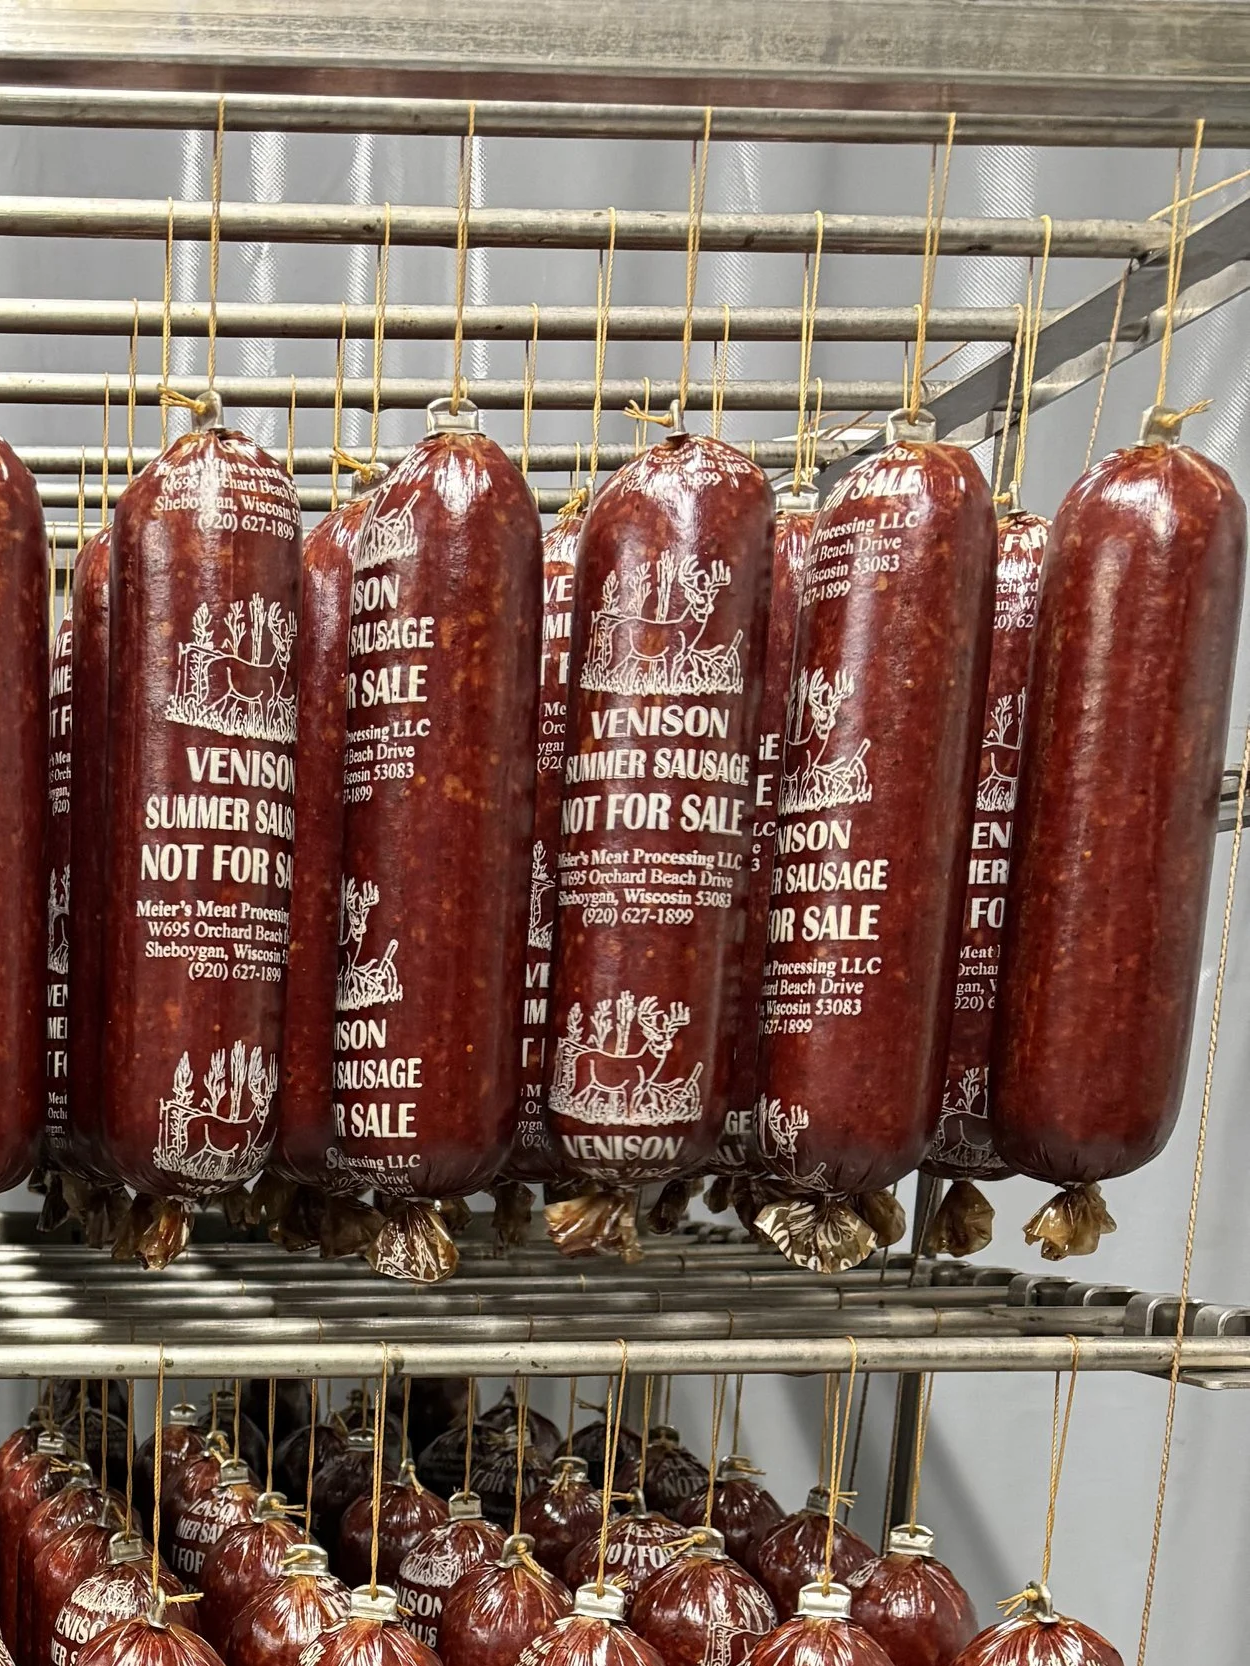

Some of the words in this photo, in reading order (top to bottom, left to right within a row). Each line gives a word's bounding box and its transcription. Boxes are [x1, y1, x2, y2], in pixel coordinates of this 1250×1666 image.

[879, 511, 919, 529] LLC
[858, 536, 903, 553] Drive
[351, 616, 435, 658] SAUSAGE
[361, 665, 428, 708] SALE
[392, 718, 431, 738] LLC
[591, 705, 730, 740] VENISON
[376, 742, 415, 761] Drive
[373, 762, 415, 781] 53083
[565, 749, 647, 785] SUMMER
[653, 748, 750, 787] SAUSAGE
[145, 794, 249, 832] SUMMER
[560, 795, 602, 836] NOT
[606, 793, 672, 831] FOR
[141, 844, 204, 881] NOT
[212, 844, 270, 886] FOR
[591, 849, 629, 866] Meat
[632, 848, 715, 870] Processing
[589, 868, 647, 885] Orchard
[650, 869, 697, 886] Beach
[785, 859, 890, 895] SAUSAGE
[136, 900, 192, 918] Meier's
[196, 901, 236, 918] Meat
[582, 907, 618, 927] (920)
[621, 907, 695, 925] 627-1899
[148, 921, 190, 937] W695
[194, 921, 251, 941] Orchard
[802, 904, 881, 942] SALE
[145, 941, 228, 961] Sheboygan,
[188, 962, 229, 981] (920)
[841, 957, 882, 975] LLC
[820, 977, 865, 995] Drive
[815, 998, 862, 1016] 53083
[336, 1057, 423, 1090] SAUSAGE
[350, 1103, 418, 1138] SALE
